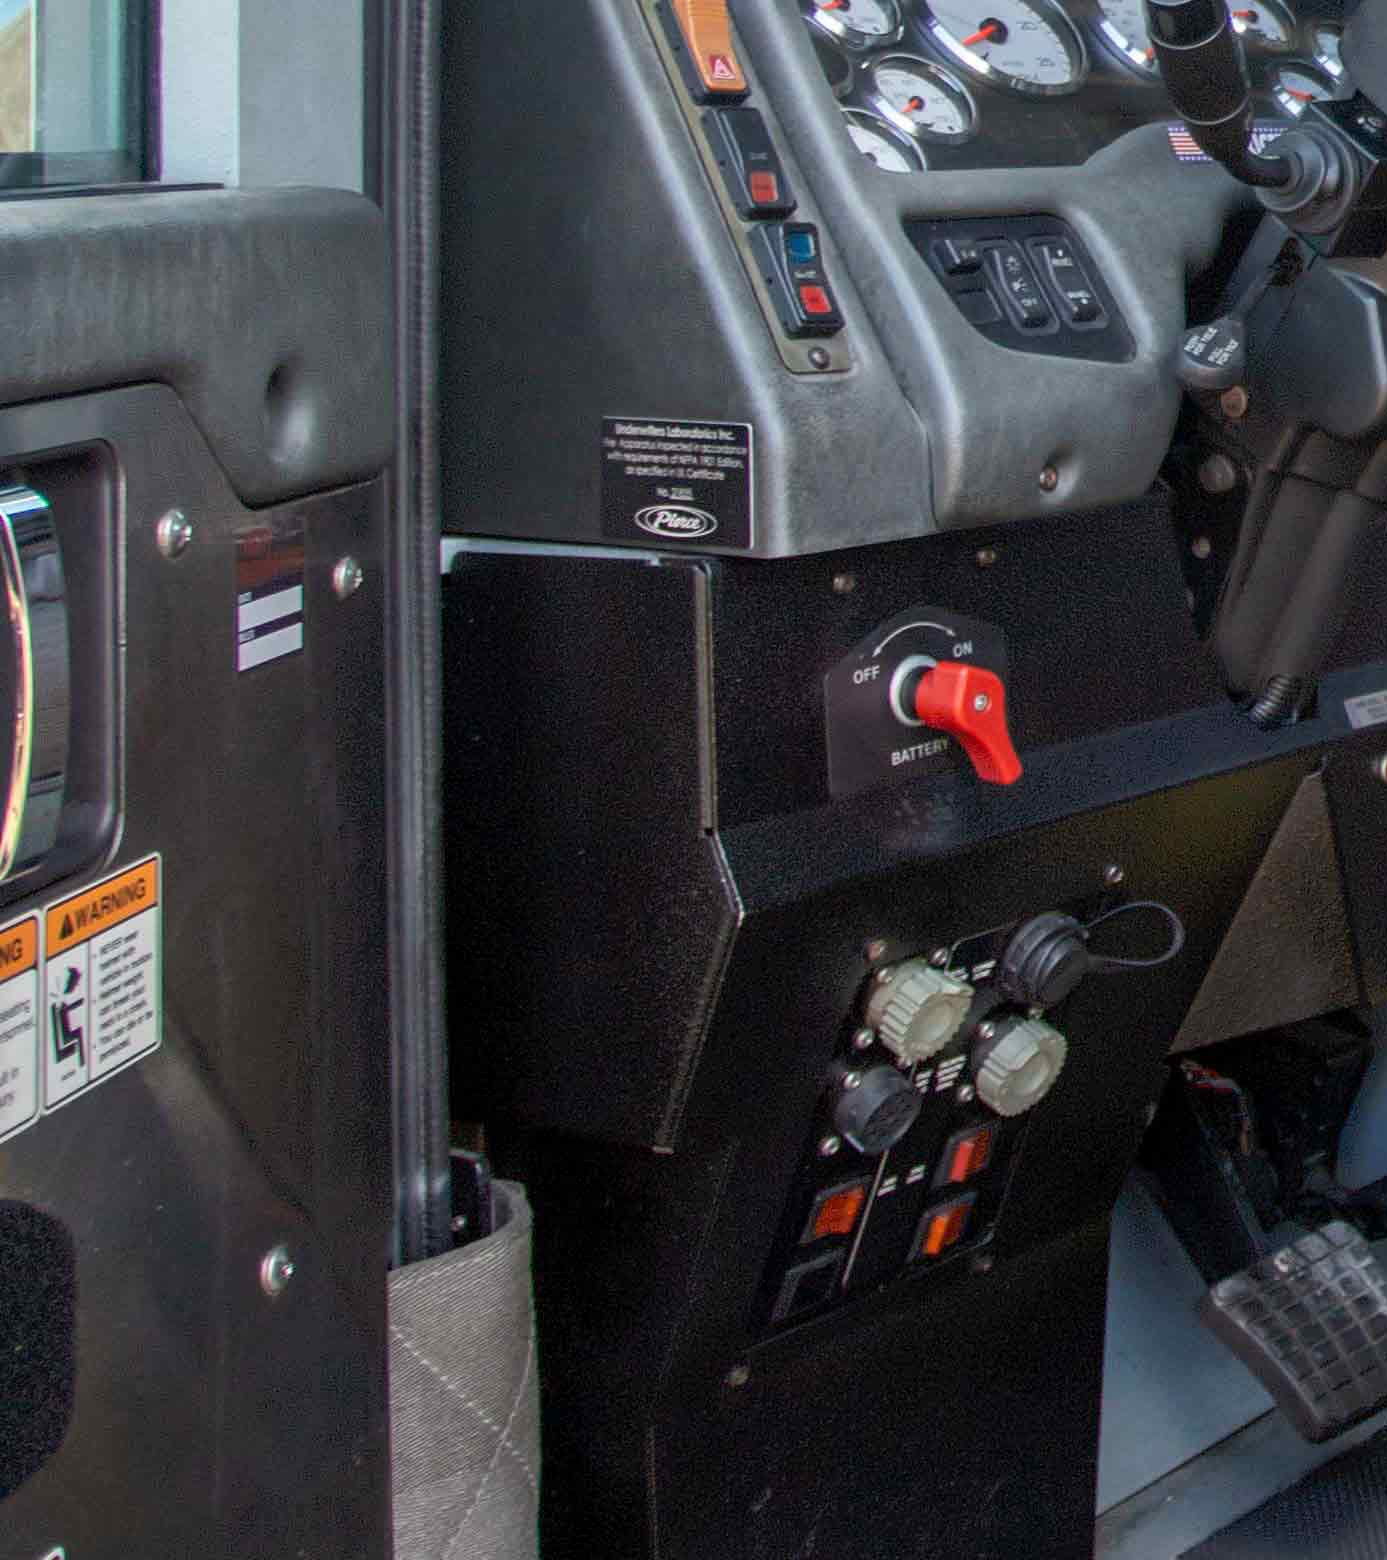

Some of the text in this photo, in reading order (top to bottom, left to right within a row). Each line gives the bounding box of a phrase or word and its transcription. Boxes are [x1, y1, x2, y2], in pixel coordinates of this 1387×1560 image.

[654, 511, 701, 530] Pierce
[953, 641, 973, 658] ON
[854, 665, 881, 684] OFF
[891, 737, 950, 766] BATTERY
[76, 878, 147, 926] WARNING
